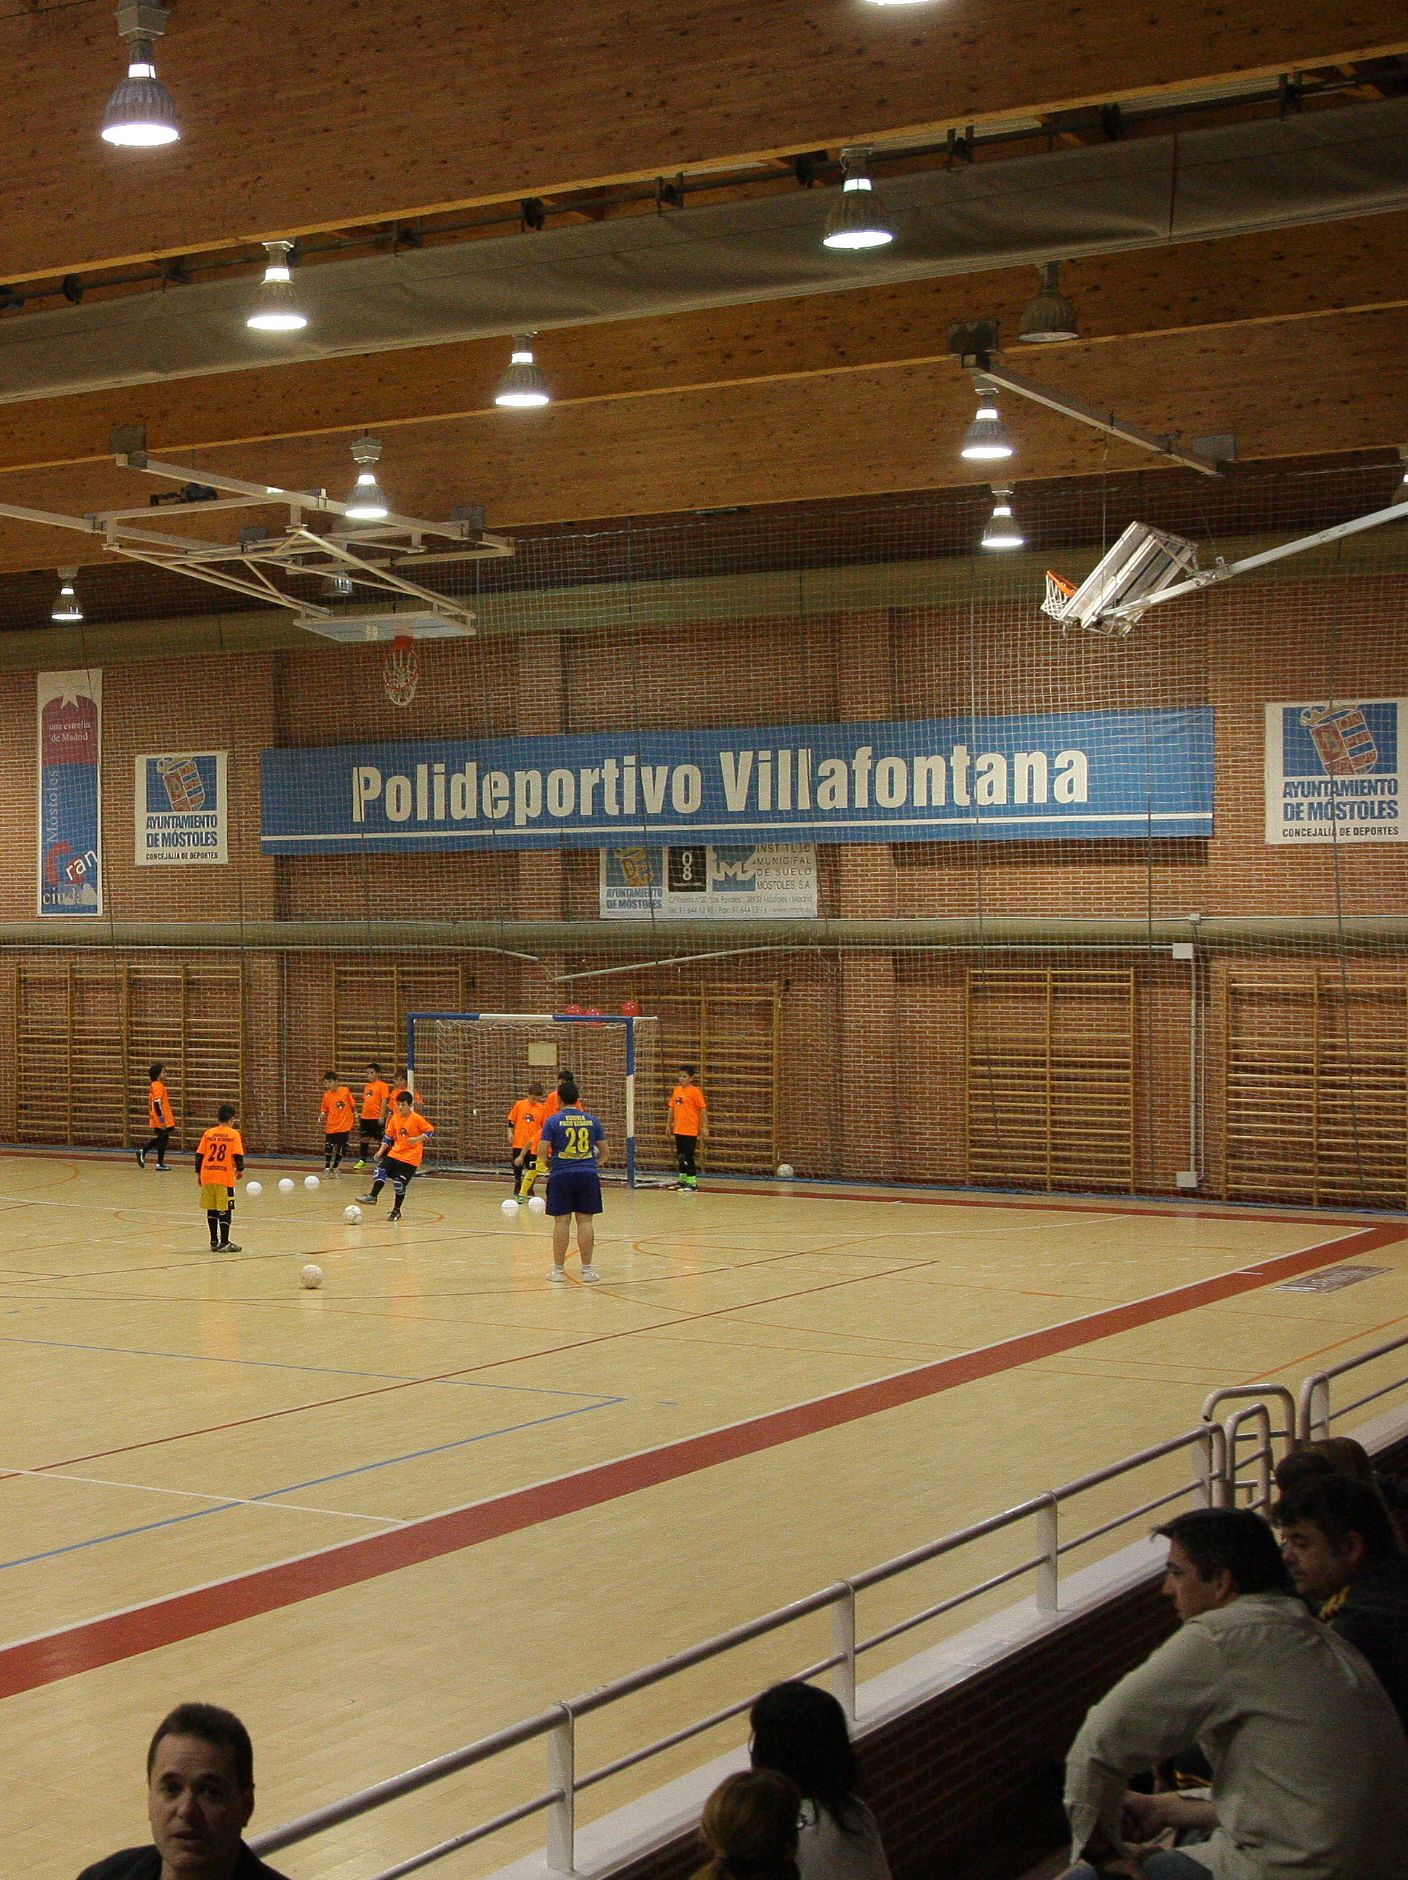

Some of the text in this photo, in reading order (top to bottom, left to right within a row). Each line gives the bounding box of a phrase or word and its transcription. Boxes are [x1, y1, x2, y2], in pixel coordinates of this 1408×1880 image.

[63, 721, 91, 730] estrella
[51, 732, 89, 742] de Madrid
[719, 745, 1089, 812] Villafontana
[352, 755, 702, 826] Polideportivo
[1282, 778, 1399, 798] AYUNTAMIENTO
[47, 769, 59, 842] Móstoles
[1283, 798, 1399, 821] DE MÓSTOLES
[146, 814, 218, 829] AYUNTAMIENTO
[147, 829, 218, 847] DE MÓSTOLES
[1339, 827, 1351, 836] DE
[1353, 826, 1399, 836] DEPORTES
[181, 852, 189, 860] DE
[190, 852, 219, 860] DEPORTES
[757, 867, 812, 877] DE SUELO
[565, 1127, 589, 1153] 28
[208, 1144, 227, 1162] 28
